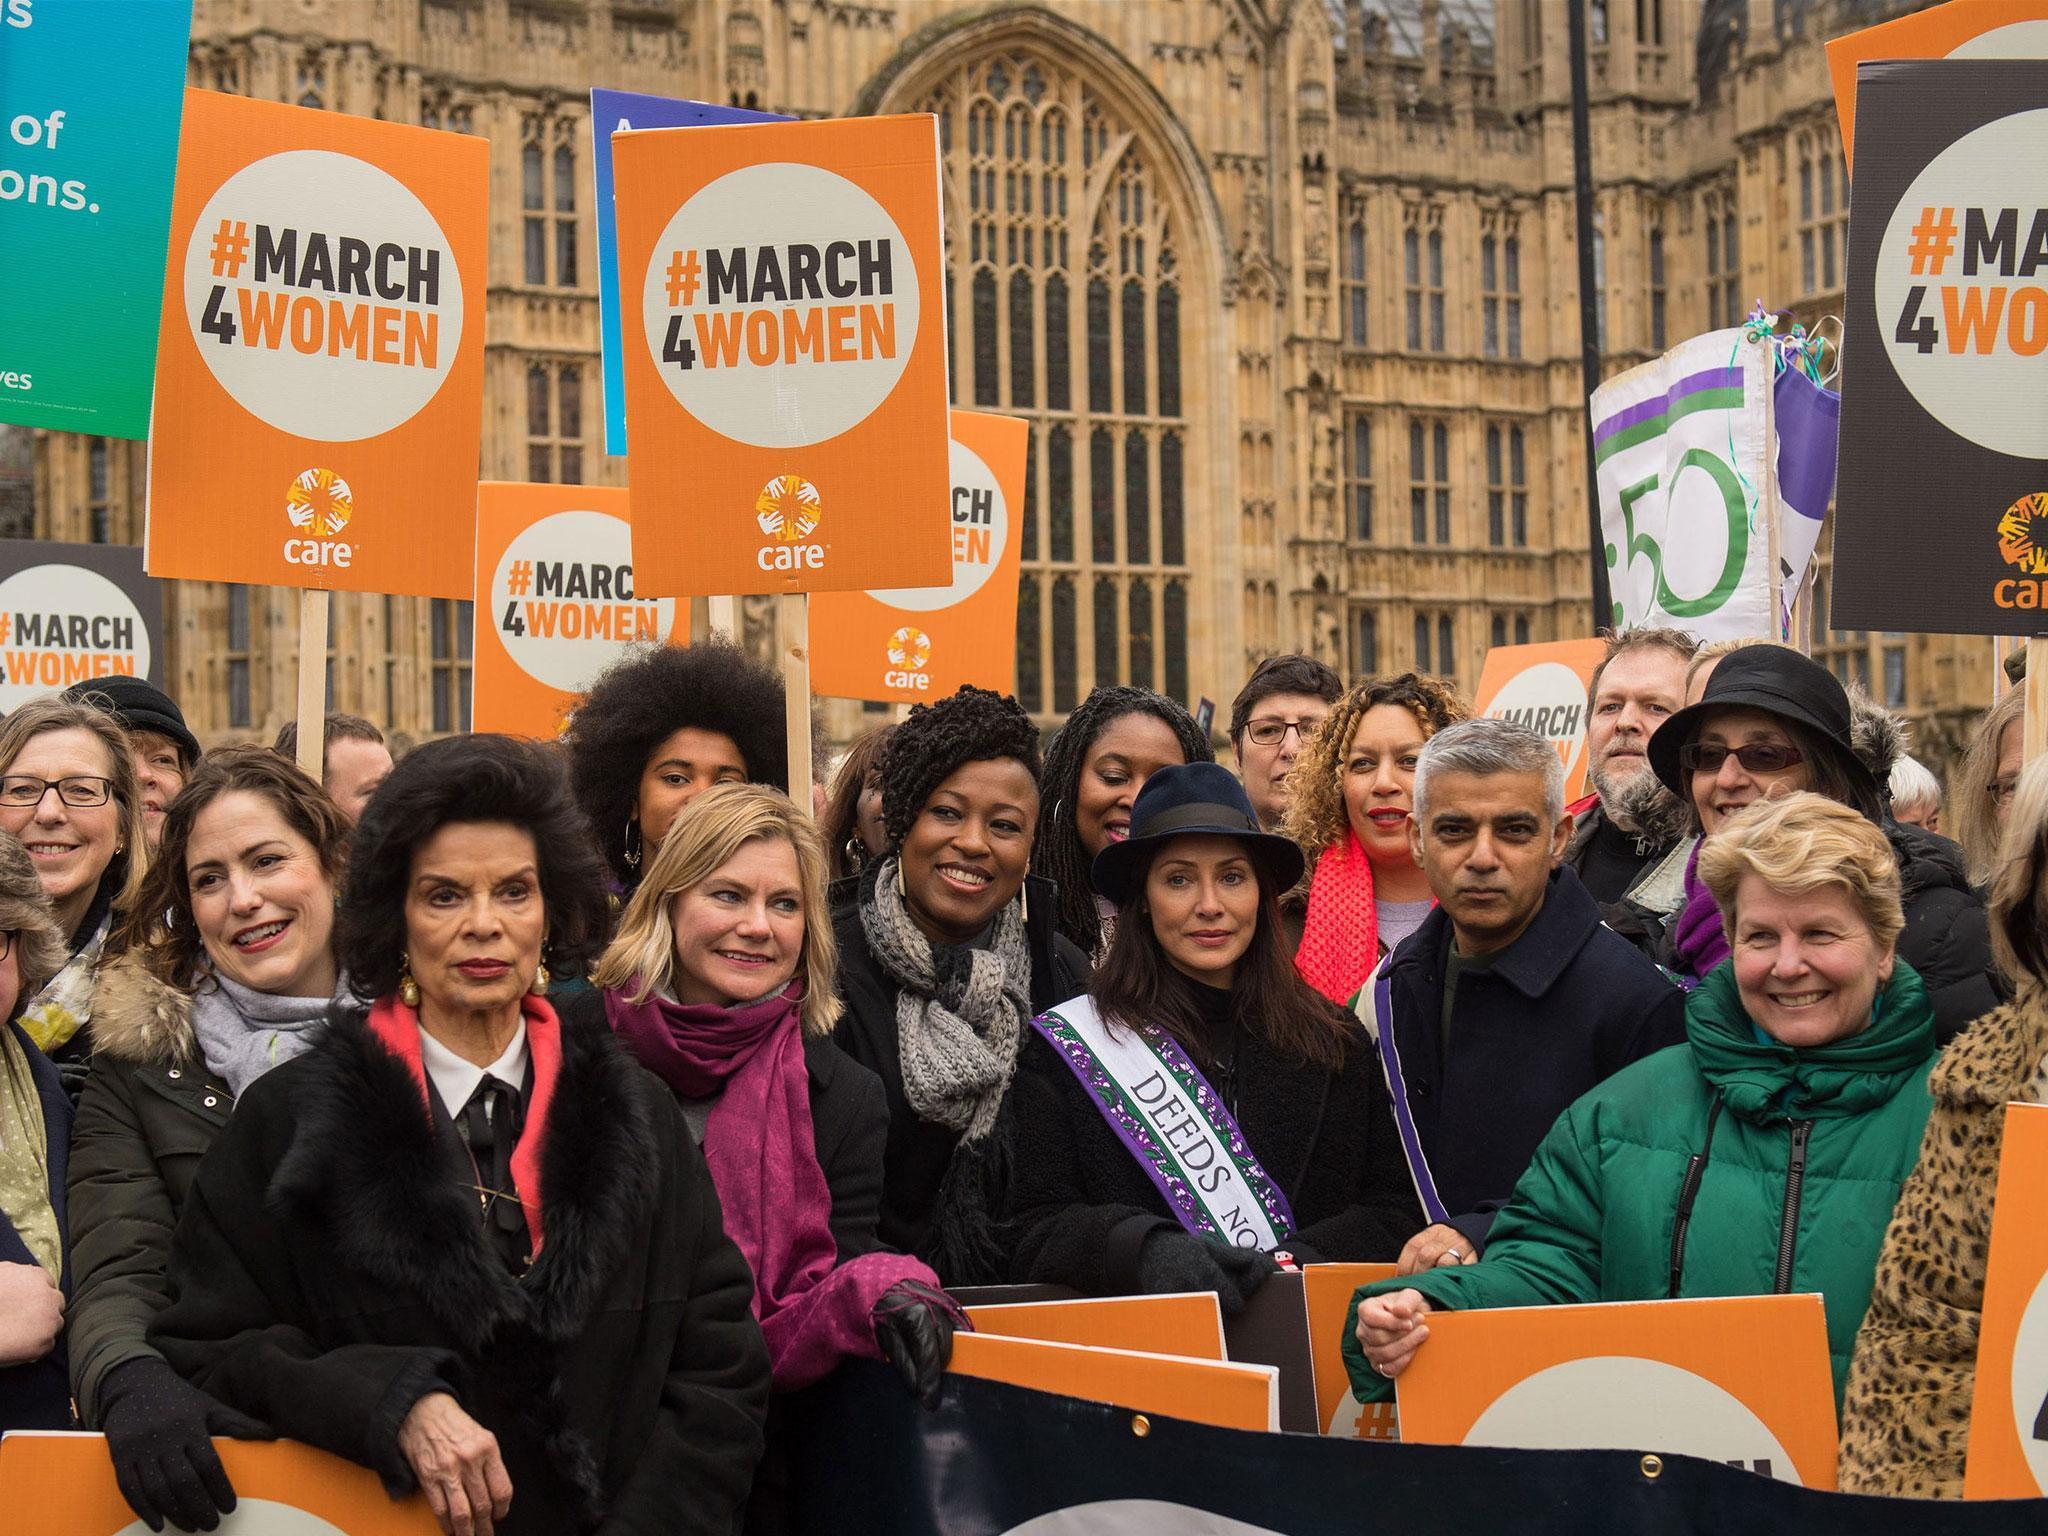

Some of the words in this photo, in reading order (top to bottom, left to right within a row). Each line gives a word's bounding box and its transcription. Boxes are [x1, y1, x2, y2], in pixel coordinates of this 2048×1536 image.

[10, 110, 67, 149] of
[210, 219, 440, 306] #MARCH
[665, 238, 893, 307] #MARCH
[201, 285, 438, 369] 4WOMEN
[662, 303, 896, 370] 4WOMEN
[284, 539, 353, 568] care
[757, 544, 825, 571] care
[507, 560, 657, 602] #MARC
[502, 601, 658, 641] 4WOMEN
[884, 670, 929, 690] care
[1130, 1070, 1231, 1193] DEEDS
[1220, 1205, 1265, 1254] NO
